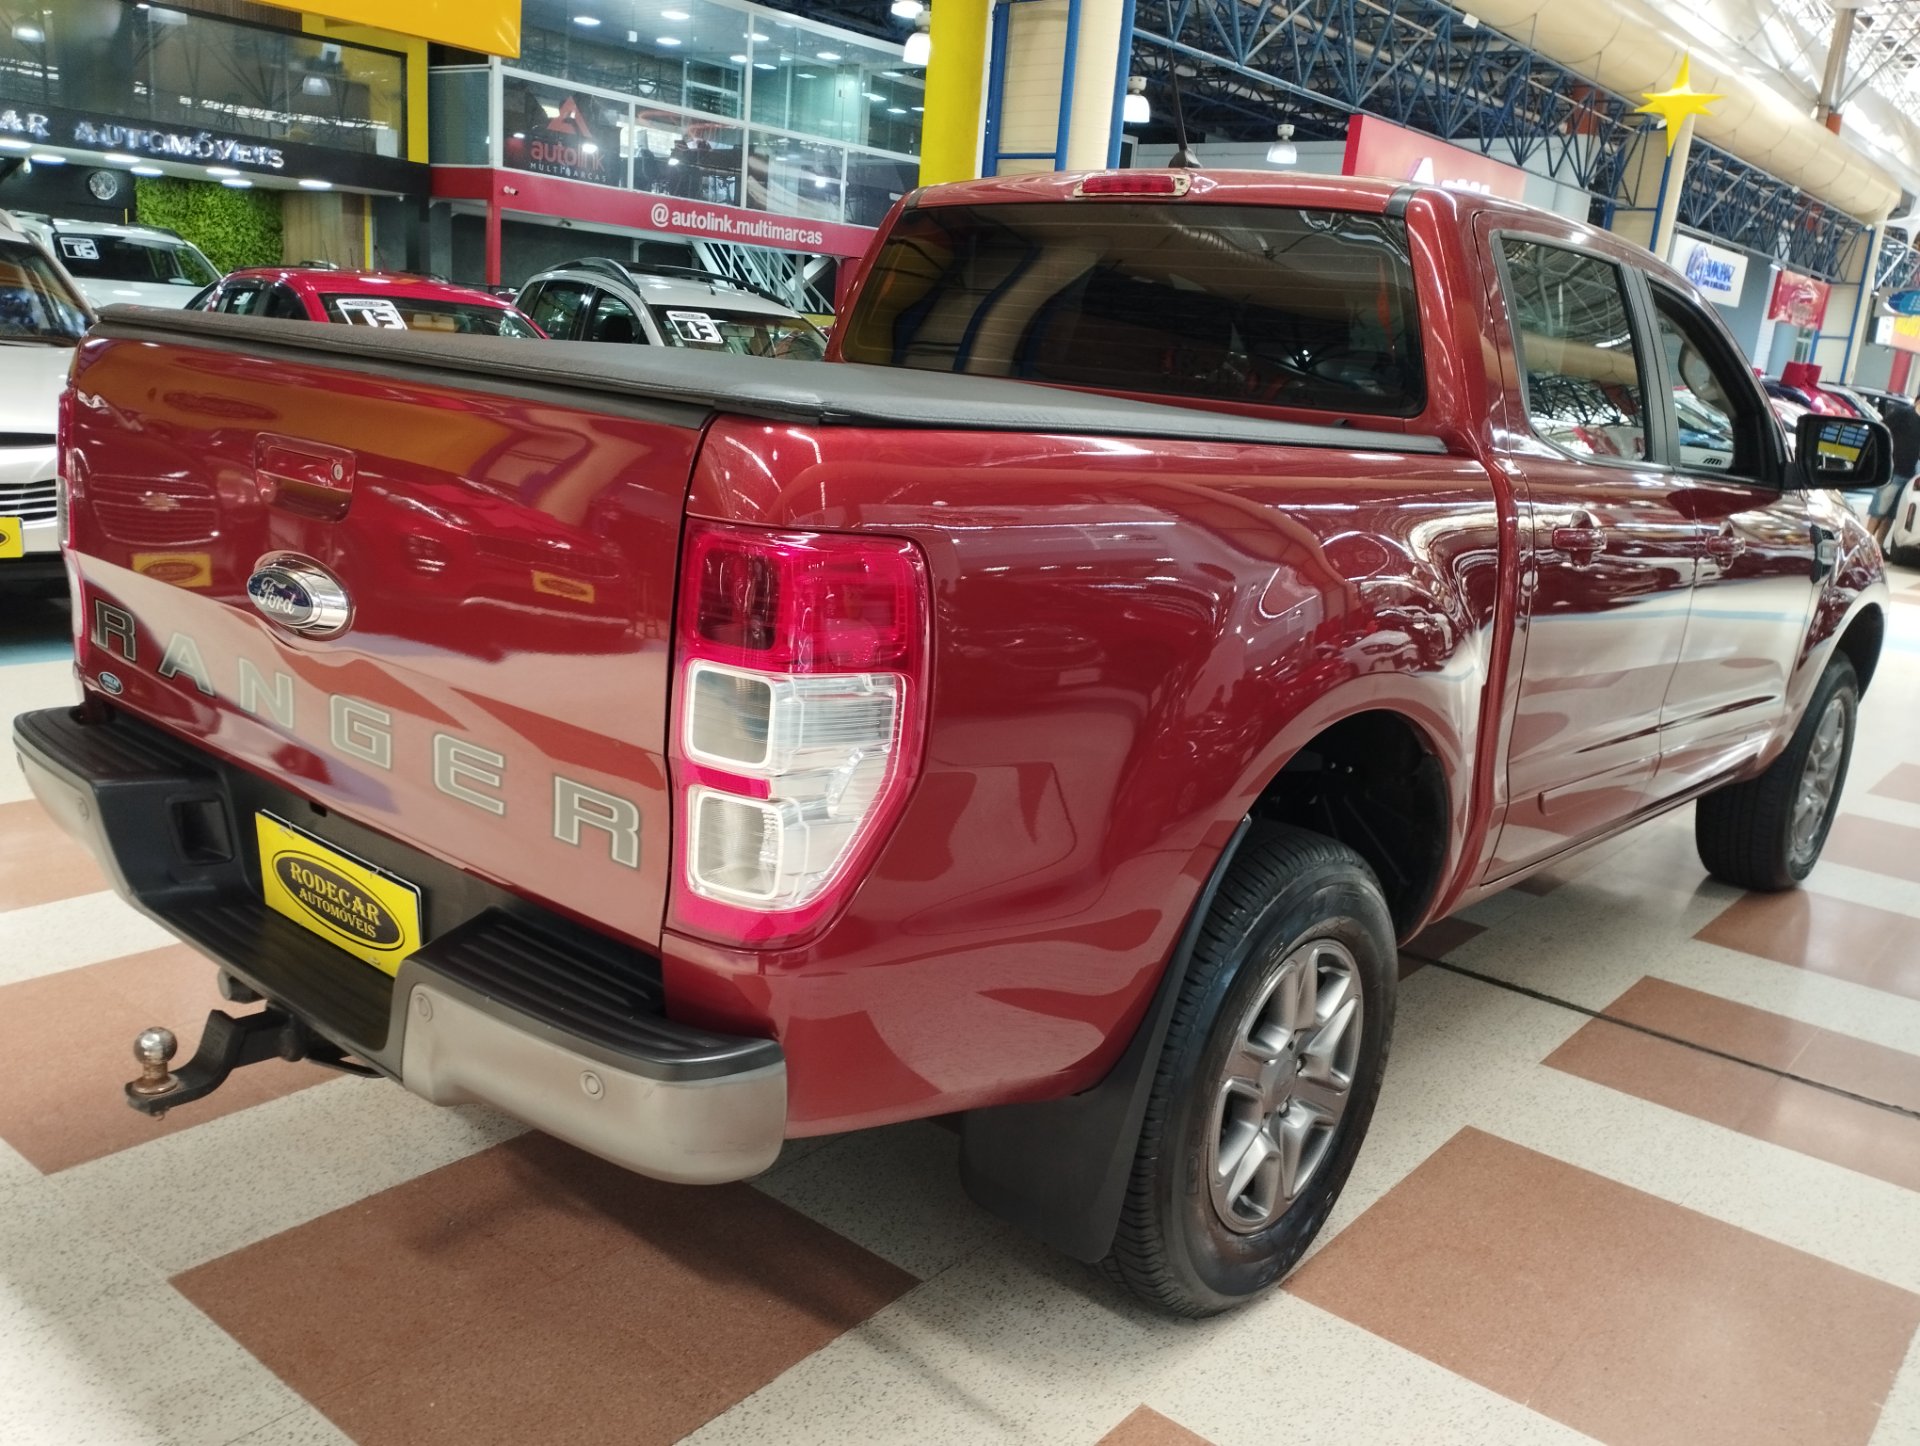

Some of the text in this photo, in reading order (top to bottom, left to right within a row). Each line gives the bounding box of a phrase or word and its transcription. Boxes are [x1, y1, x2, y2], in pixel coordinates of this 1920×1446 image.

[531, 140, 605, 172] autolink
[257, 576, 296, 616] Ford
[95, 599, 639, 870] RANGER
[290, 862, 382, 926] RODECAR
[300, 888, 376, 938] AUTOMÓVEIS
